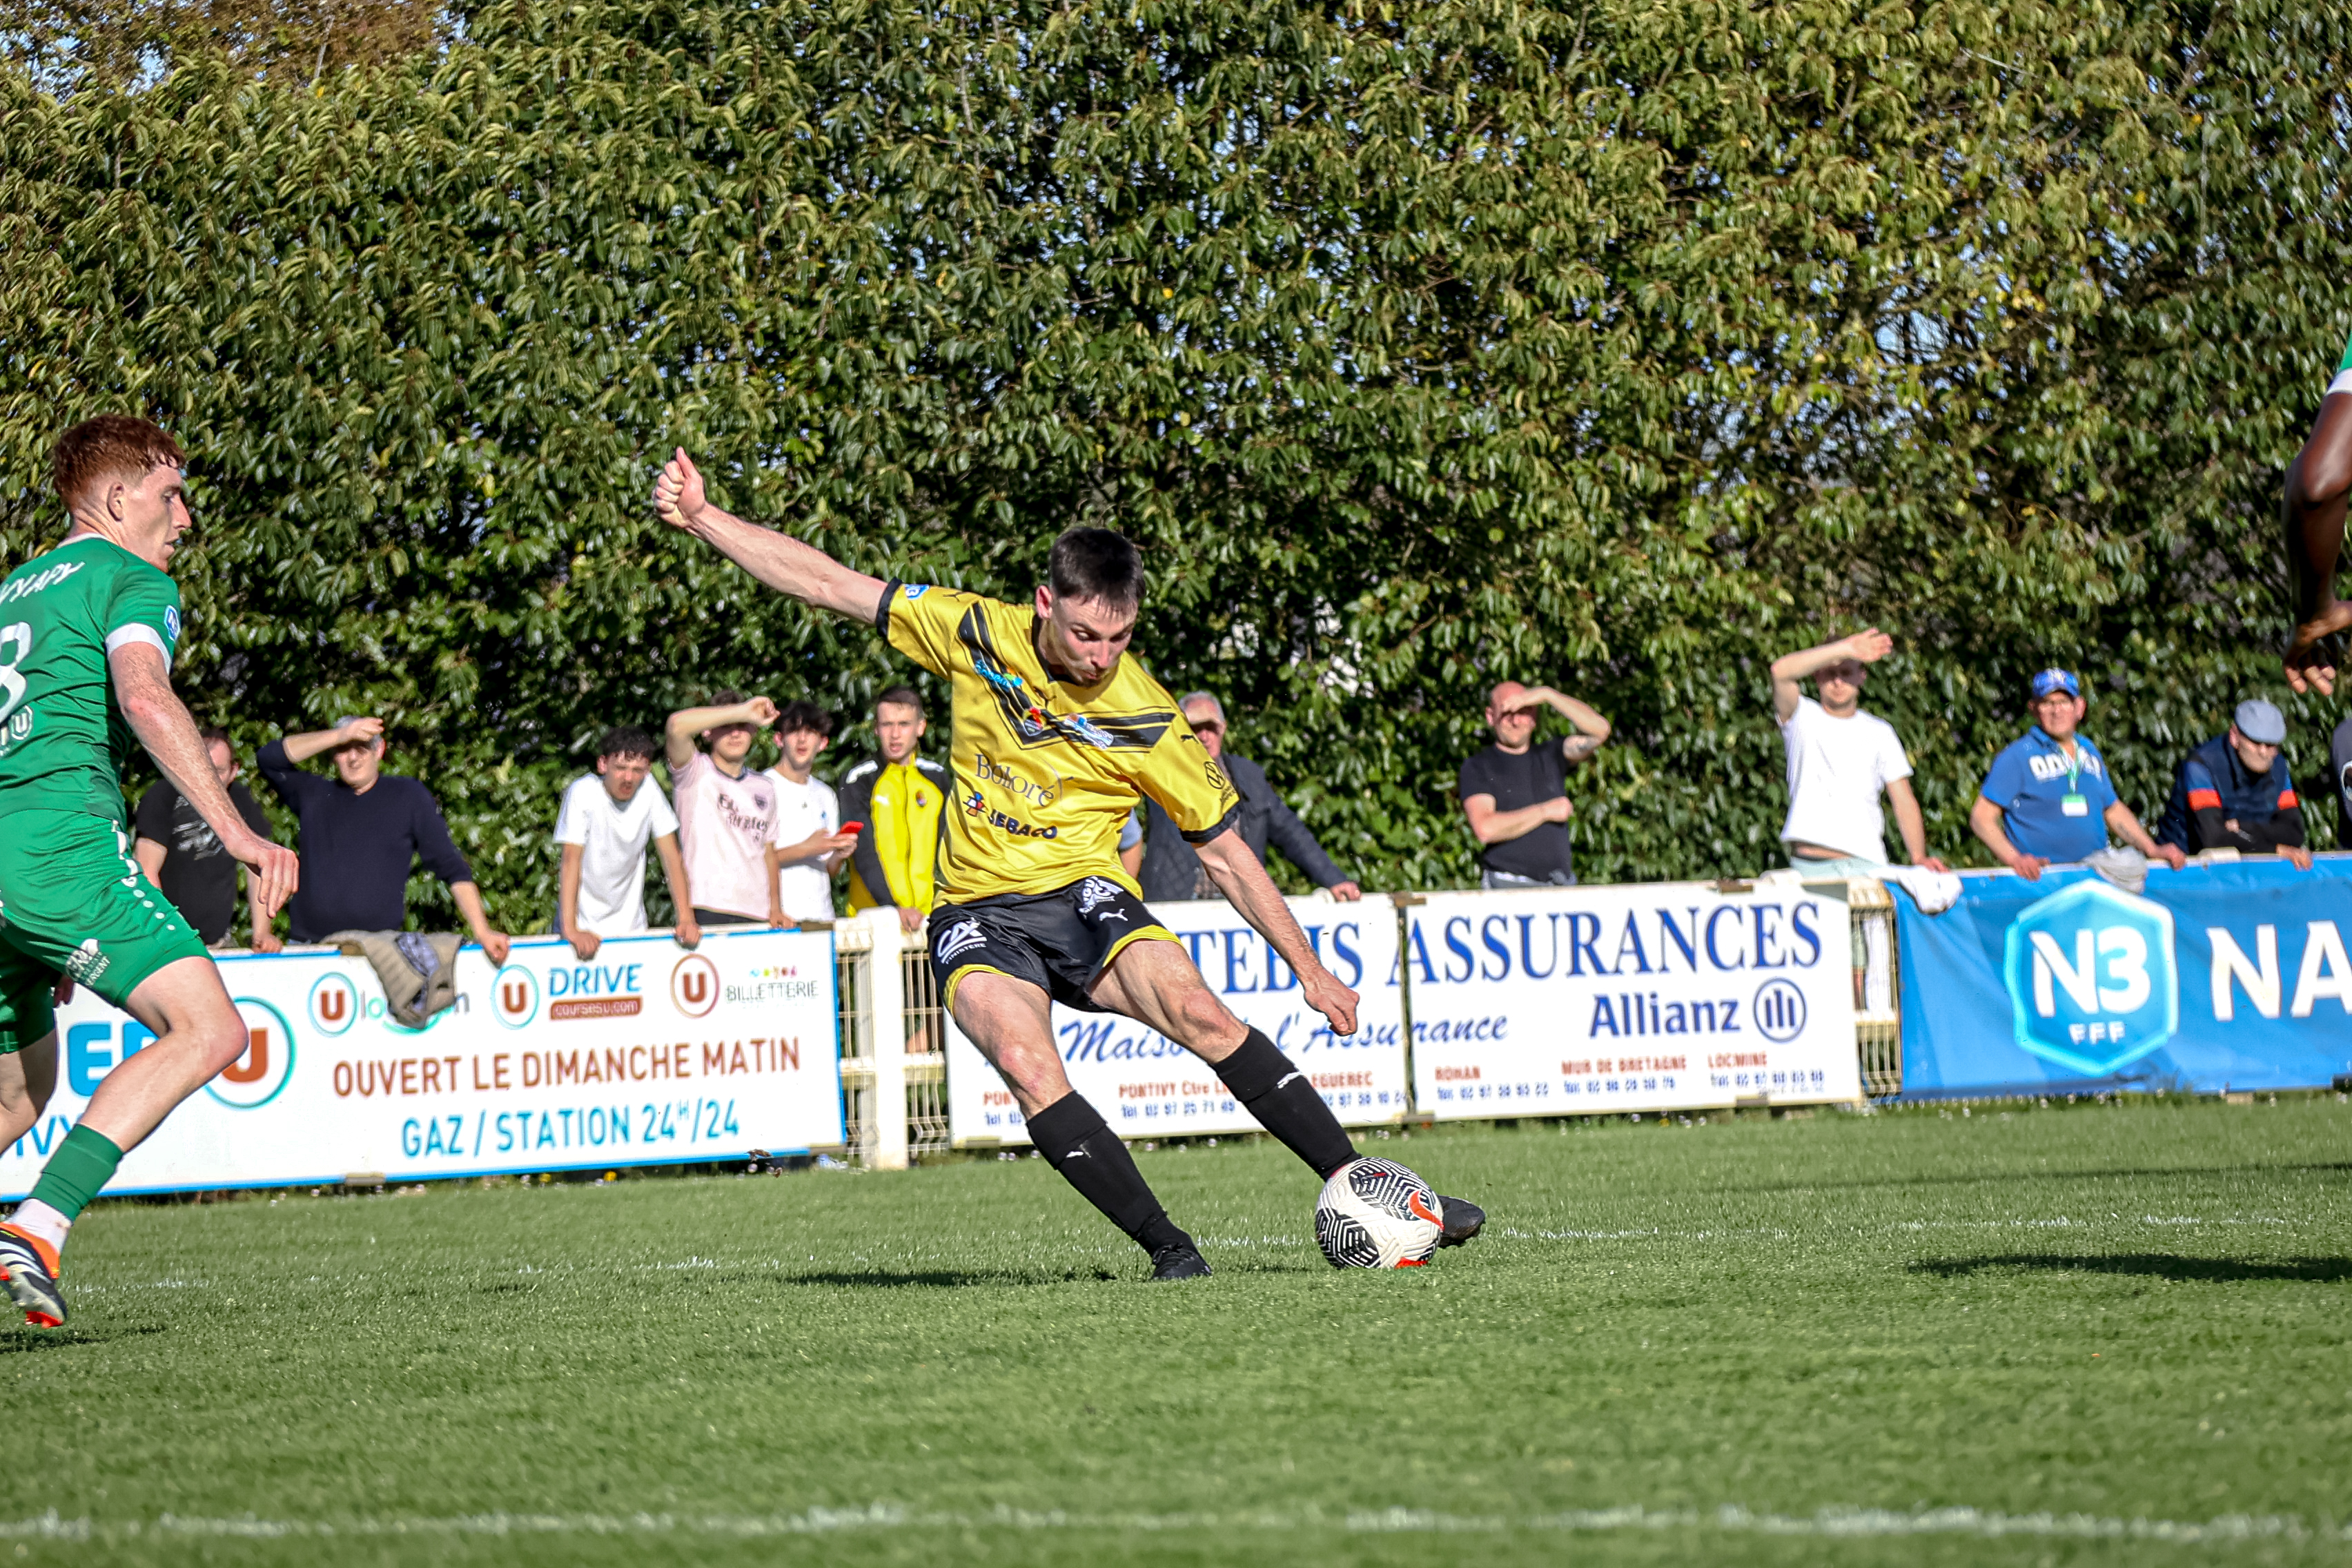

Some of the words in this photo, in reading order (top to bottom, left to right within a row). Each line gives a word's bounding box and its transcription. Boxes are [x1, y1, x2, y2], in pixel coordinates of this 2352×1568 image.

[1386, 901, 1823, 988] ASSURANCES
[548, 963, 643, 997] DRIVE
[725, 980, 819, 1003] BILLETTERIE
[2029, 925, 2151, 1019] N3
[1590, 992, 1741, 1039] Allianz
[2068, 1021, 2126, 1044] FFF
[1059, 1019, 1187, 1064] Maiso
[333, 1056, 462, 1098] OUVERT
[473, 1052, 511, 1090] LE
[522, 1042, 692, 1088] DIMANCHE
[702, 1037, 801, 1076] MATIN
[1618, 1055, 1687, 1074] BRETAGNE
[1119, 1081, 1176, 1099] PONTIVY
[401, 1114, 465, 1159] GAZ
[496, 1105, 631, 1153] STATION
